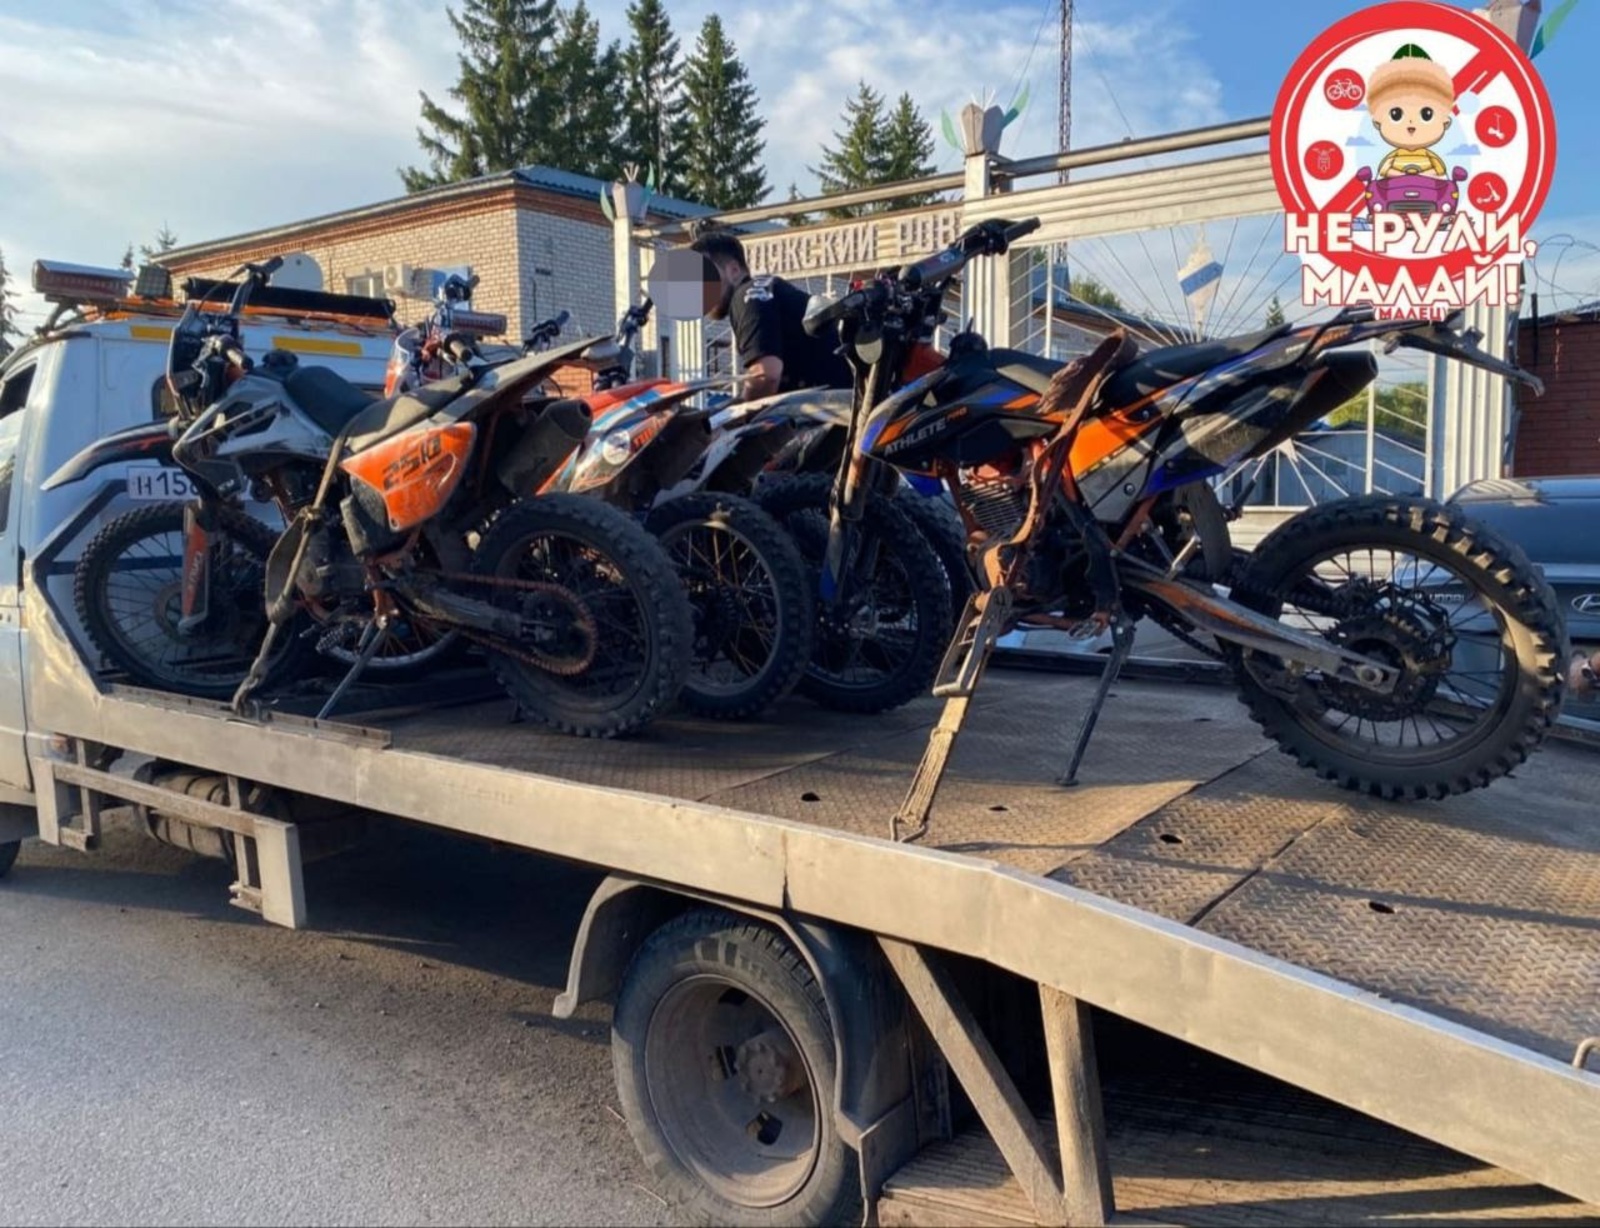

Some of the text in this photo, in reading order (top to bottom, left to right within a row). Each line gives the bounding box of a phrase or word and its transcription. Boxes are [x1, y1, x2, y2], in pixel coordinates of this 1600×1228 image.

[747, 209, 962, 273] ДЯКСКИЙ РОВ
[884, 417, 947, 457] ATHLETE
